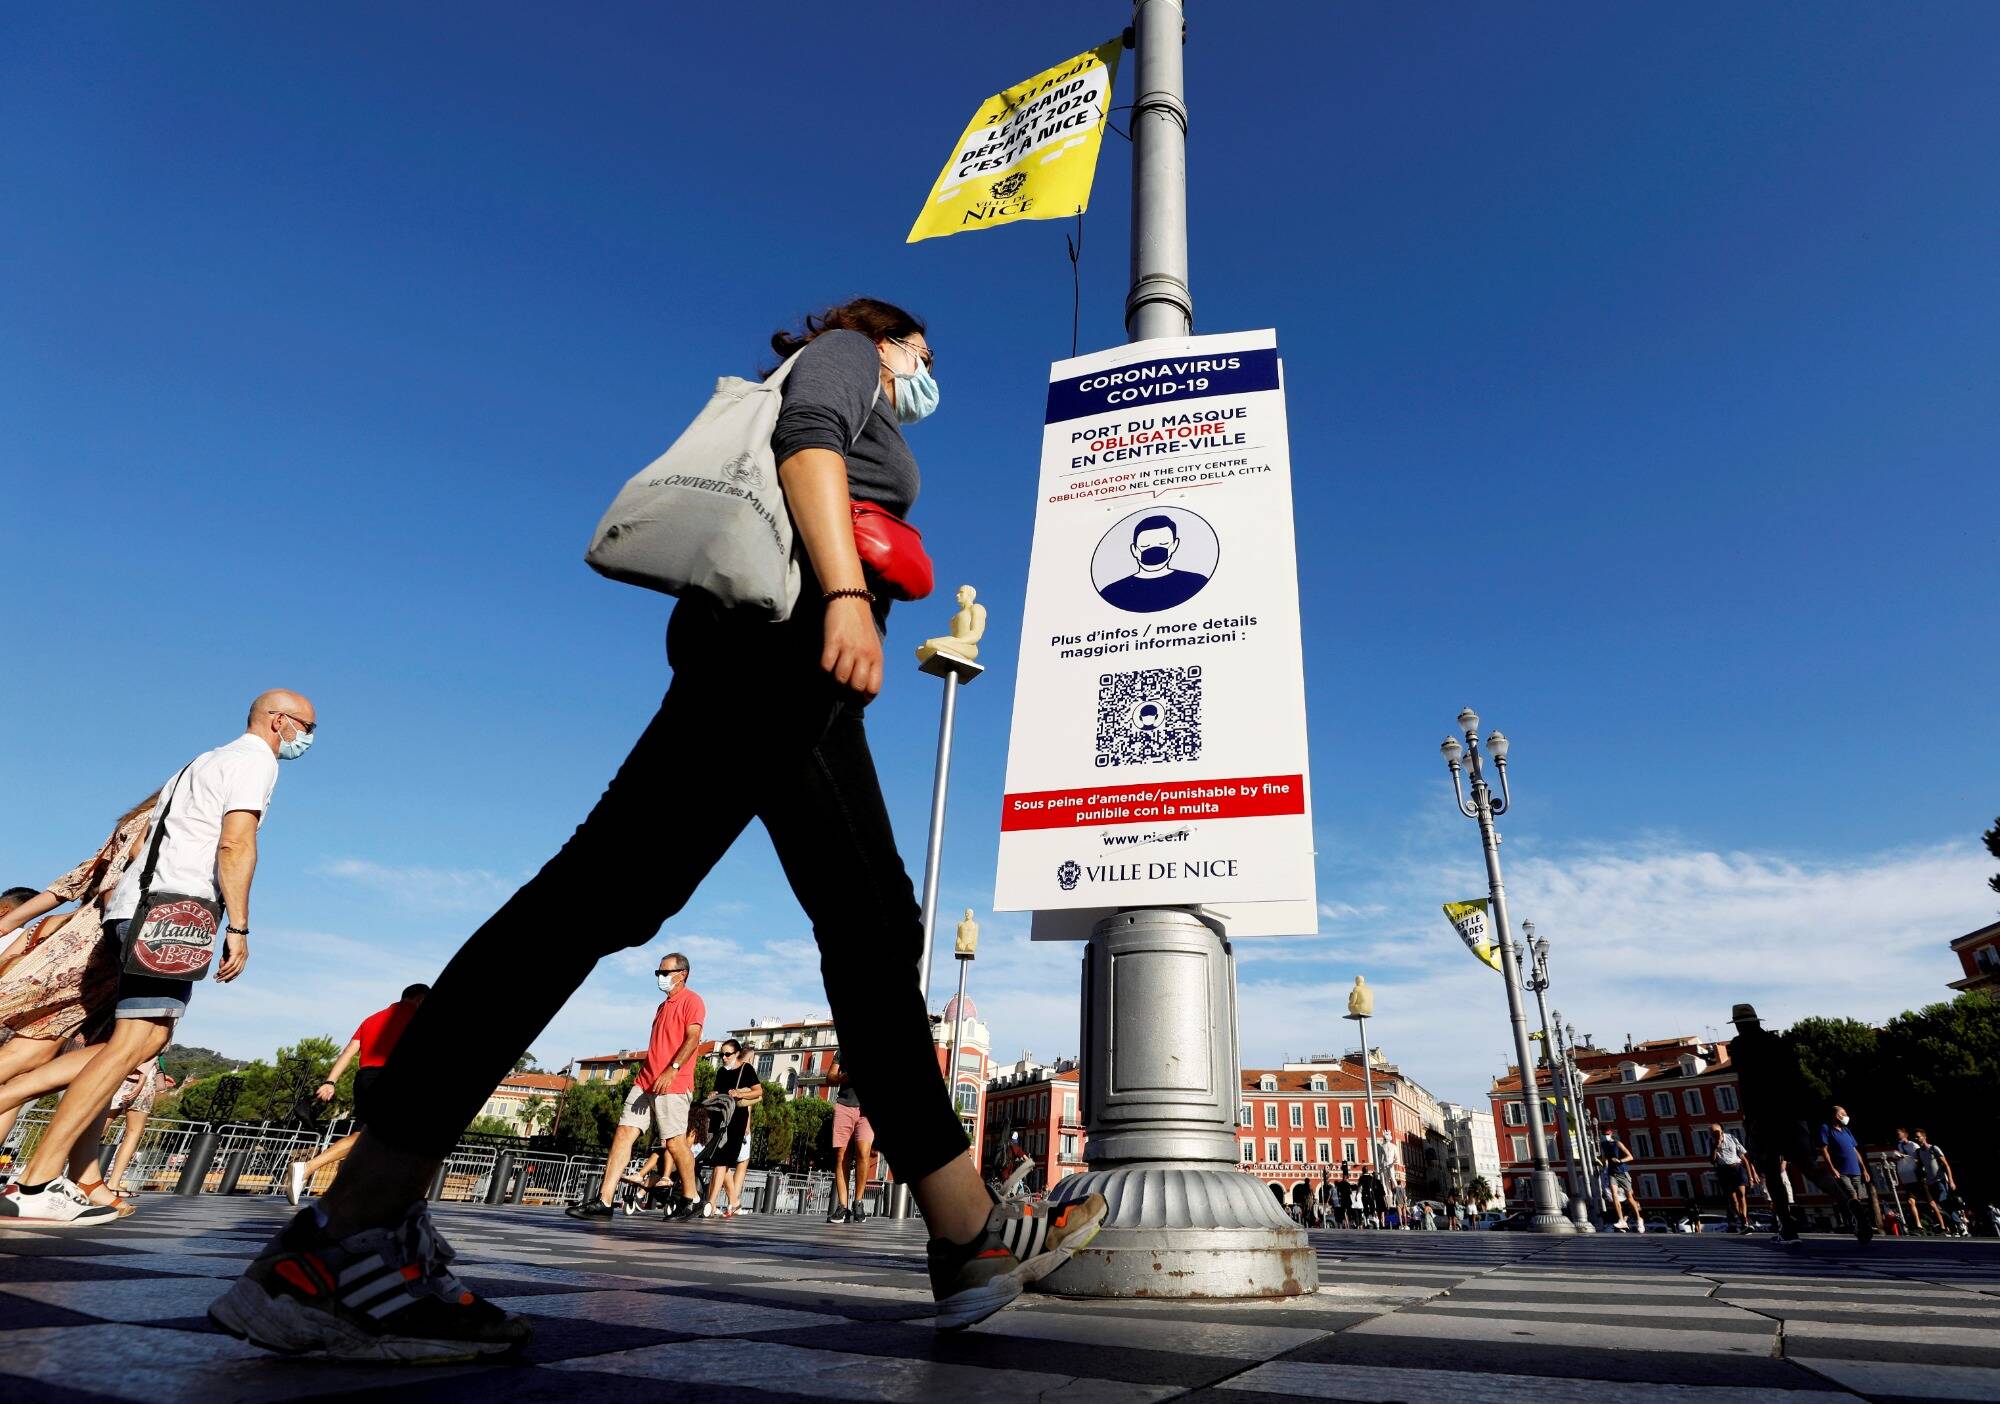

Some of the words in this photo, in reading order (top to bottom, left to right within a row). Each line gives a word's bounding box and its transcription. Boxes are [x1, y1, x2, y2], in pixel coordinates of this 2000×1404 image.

[988, 122, 1012, 141] LE
[1015, 80, 1085, 125] GRAND
[960, 115, 1042, 163] DÉPART
[1045, 90, 1098, 122] 2020
[959, 148, 1017, 177] C'EST
[1019, 136, 1031, 155] À
[1037, 111, 1088, 142] NICE
[963, 199, 1033, 224] NICE
[1079, 357, 1241, 392] CORONAVIRUS
[1107, 378, 1209, 404] COVID-19
[1071, 424, 1121, 443] PORT
[1128, 418, 1154, 433] DU
[1162, 407, 1247, 427] MASQUE
[1090, 422, 1226, 452] OBLIGATOIRE
[1071, 454, 1096, 469] EN
[1102, 432, 1246, 463] CENTRE-VILLE
[1049, 485, 1126, 503] OBBLIGATORIO
[1129, 481, 1149, 490] NEL
[1153, 474, 1196, 486] CENTRO
[1200, 470, 1235, 480] DELLA
[1239, 463, 1271, 475] CITTÀ
[1070, 473, 1137, 490] OBLIGATORY
[1140, 470, 1150, 478] IN
[1154, 467, 1173, 476] THE
[1177, 463, 1202, 473] CITY
[1205, 458, 1248, 470] CENTRE
[1052, 635, 1081, 646] Plus
[1156, 622, 1197, 634] more
[1203, 615, 1257, 629] details
[1060, 641, 1129, 658] maggiori
[1135, 630, 1236, 650] informazioni
[1014, 799, 1045, 811] Sous
[1047, 796, 1083, 810] peine
[1240, 784, 1257, 797] by
[1262, 783, 1290, 794] fine
[1076, 806, 1130, 821] punibile
[1134, 807, 1159, 817] con
[1163, 804, 1176, 815] la
[1179, 803, 1219, 814] multa
[1104, 831, 1190, 846] wwwnice.fr
[1085, 862, 1142, 883] VILLE
[1148, 861, 1176, 880] DE
[1184, 859, 1238, 878] NICE
[160, 904, 212, 926] WANTED
[1471, 915, 1480, 925] LE
[145, 919, 211, 940] Madrid
[1469, 924, 1483, 936] DES
[155, 944, 205, 968] Bag
